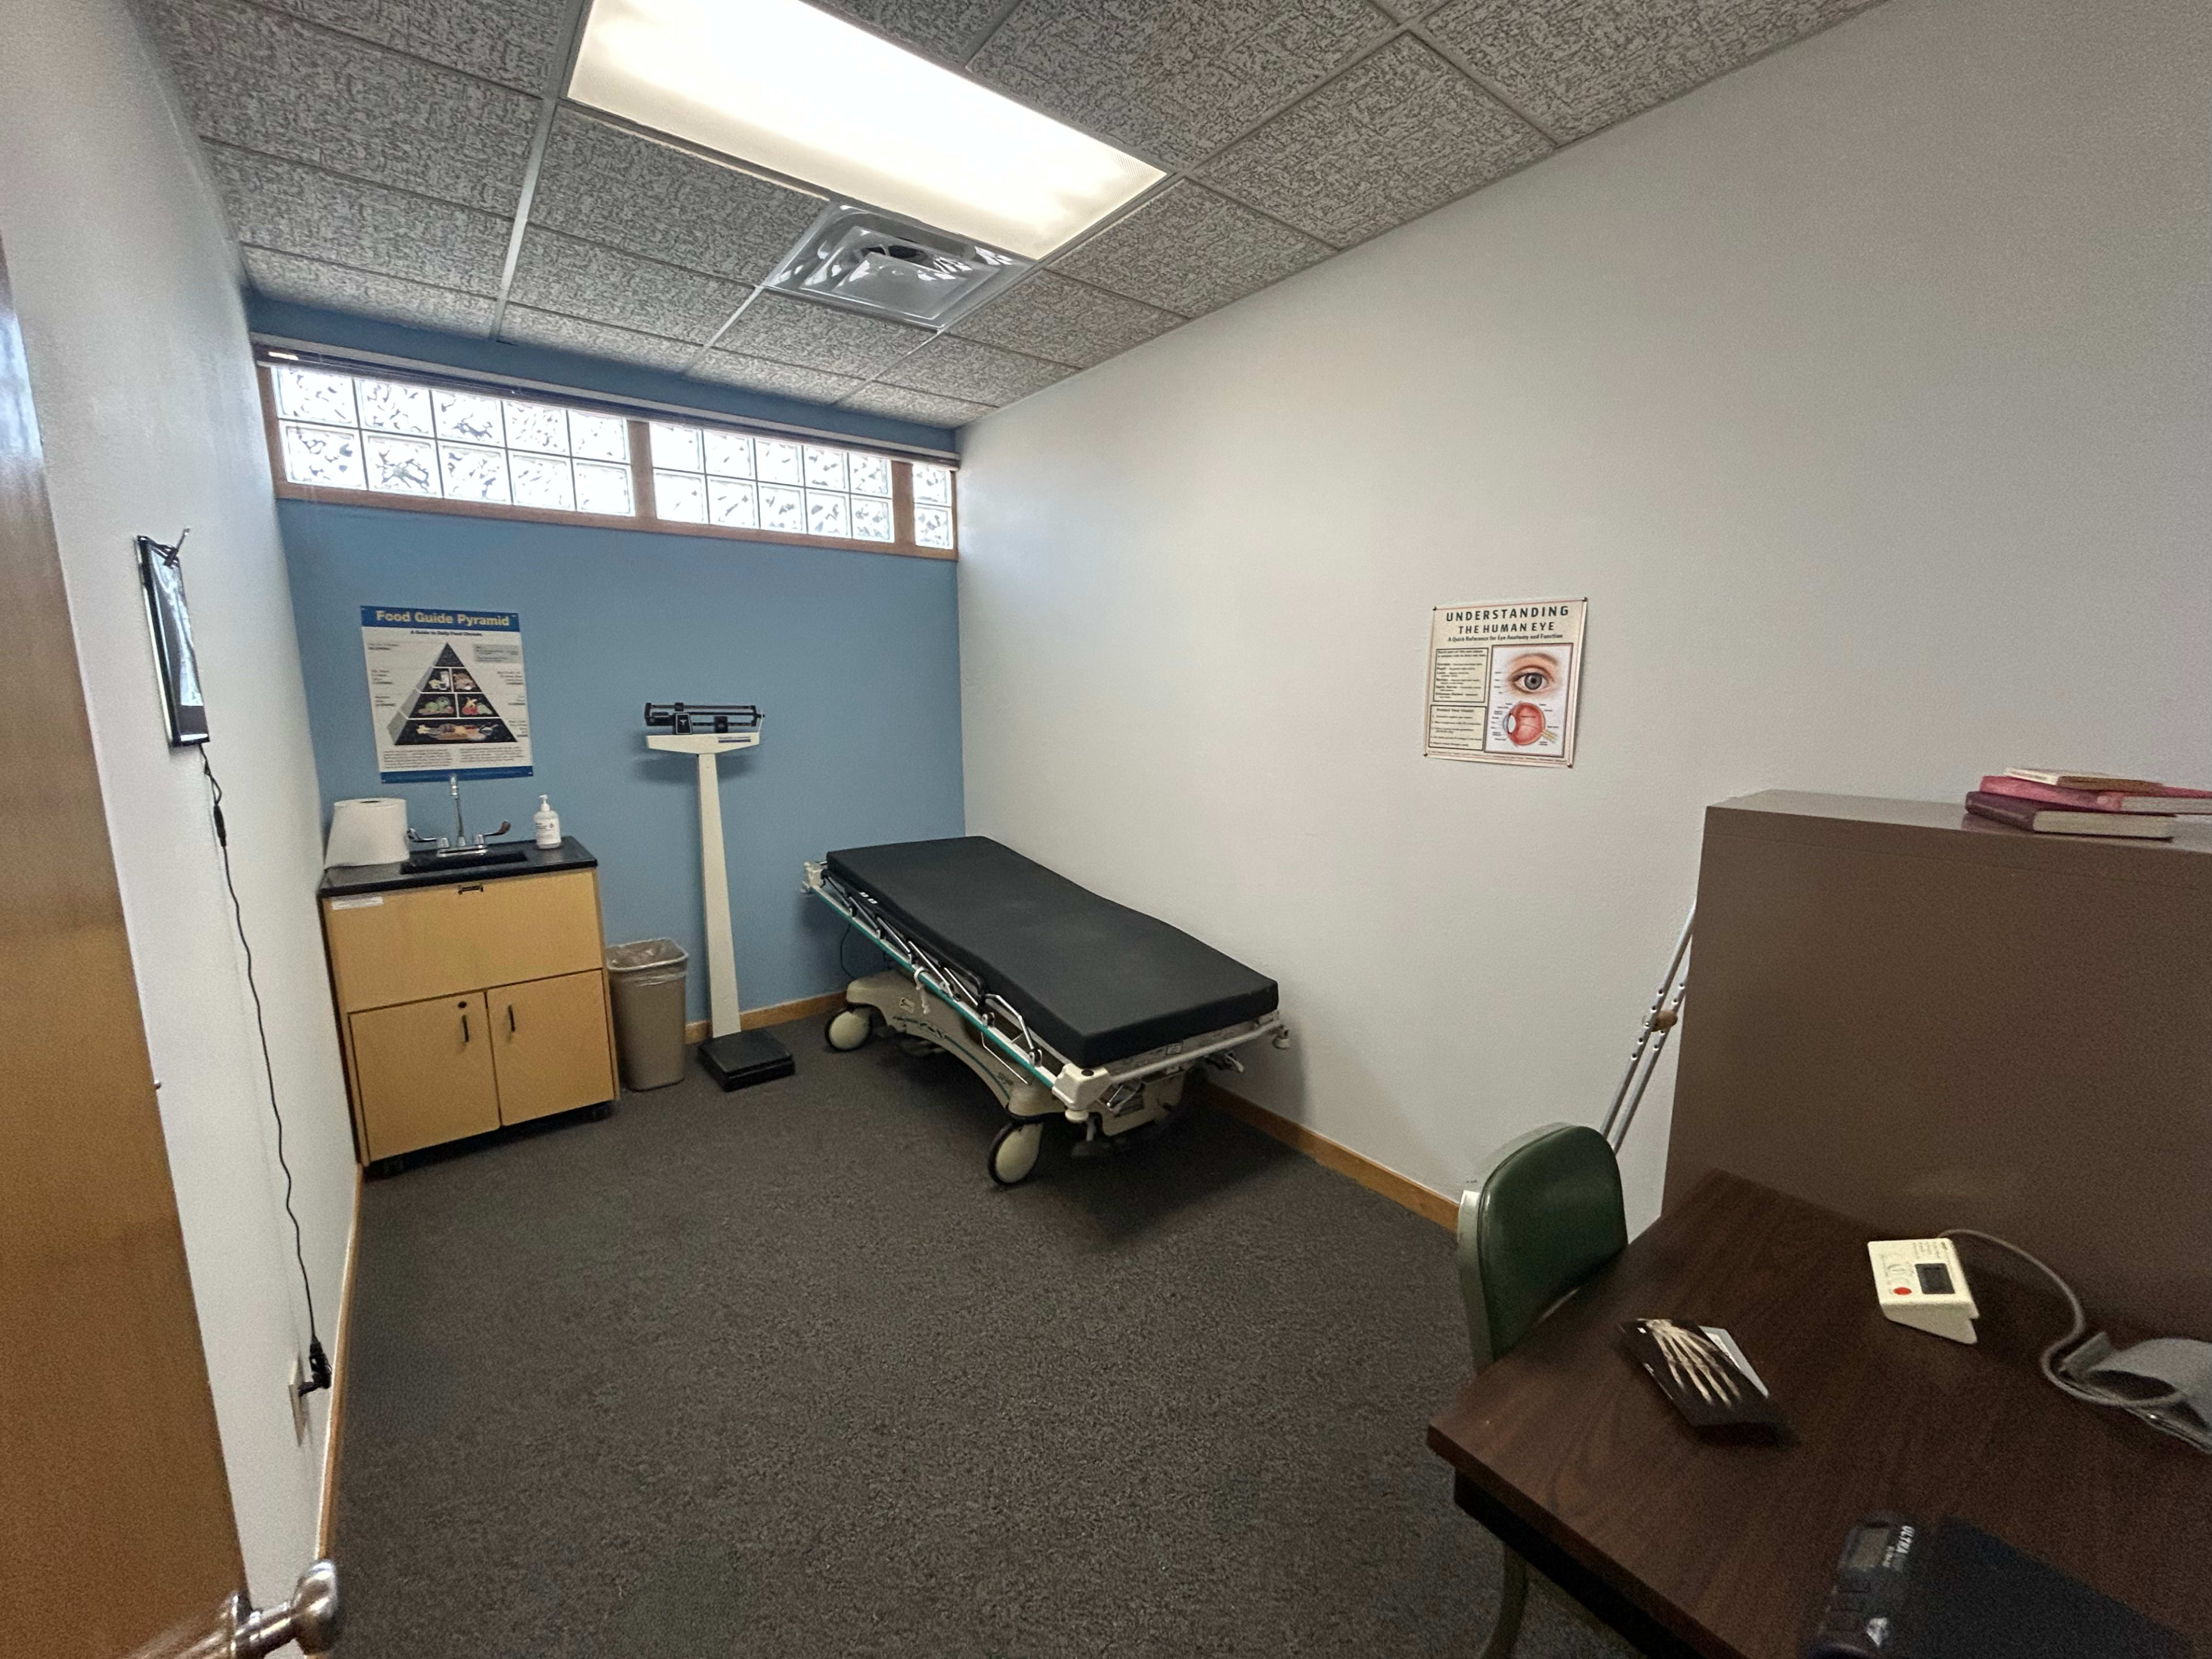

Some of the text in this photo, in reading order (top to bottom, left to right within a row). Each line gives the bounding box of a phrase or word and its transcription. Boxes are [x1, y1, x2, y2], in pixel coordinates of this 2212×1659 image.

[376, 610, 509, 626] Food Guide Pyramid
[1446, 606, 1569, 622] UNDERSTANDING
[1459, 622, 1554, 634] THE HUMAN EYE
[1896, 1525, 1915, 1554] ULTRA
